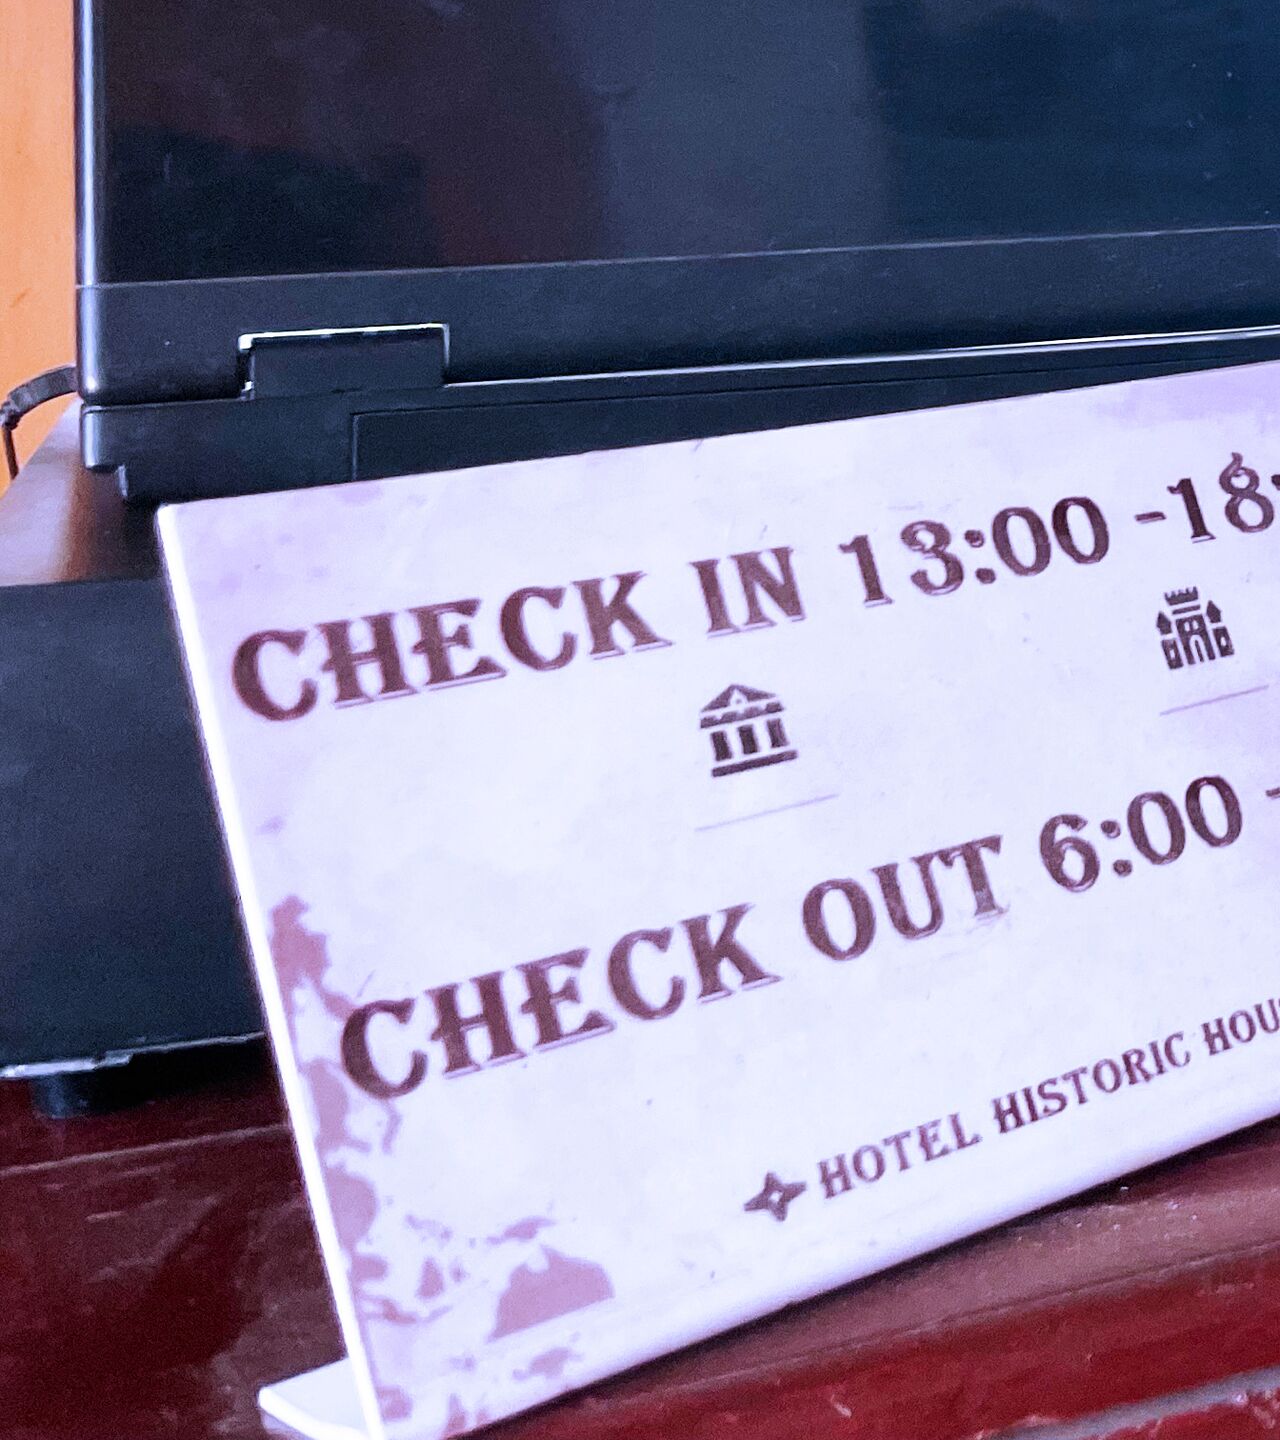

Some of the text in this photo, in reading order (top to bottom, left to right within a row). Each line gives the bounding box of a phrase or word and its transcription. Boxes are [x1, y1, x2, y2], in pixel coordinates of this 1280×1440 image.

[231, 570, 674, 723] CHECK
[688, 545, 807, 639] IN
[838, 496, 1110, 608] 13:00
[340, 902, 783, 1100] CHECK
[801, 833, 1009, 962] OUT
[1038, 773, 1243, 892] 6:00
[817, 1111, 983, 1201] HOTEL
[991, 1031, 1193, 1135] HISTORIC
